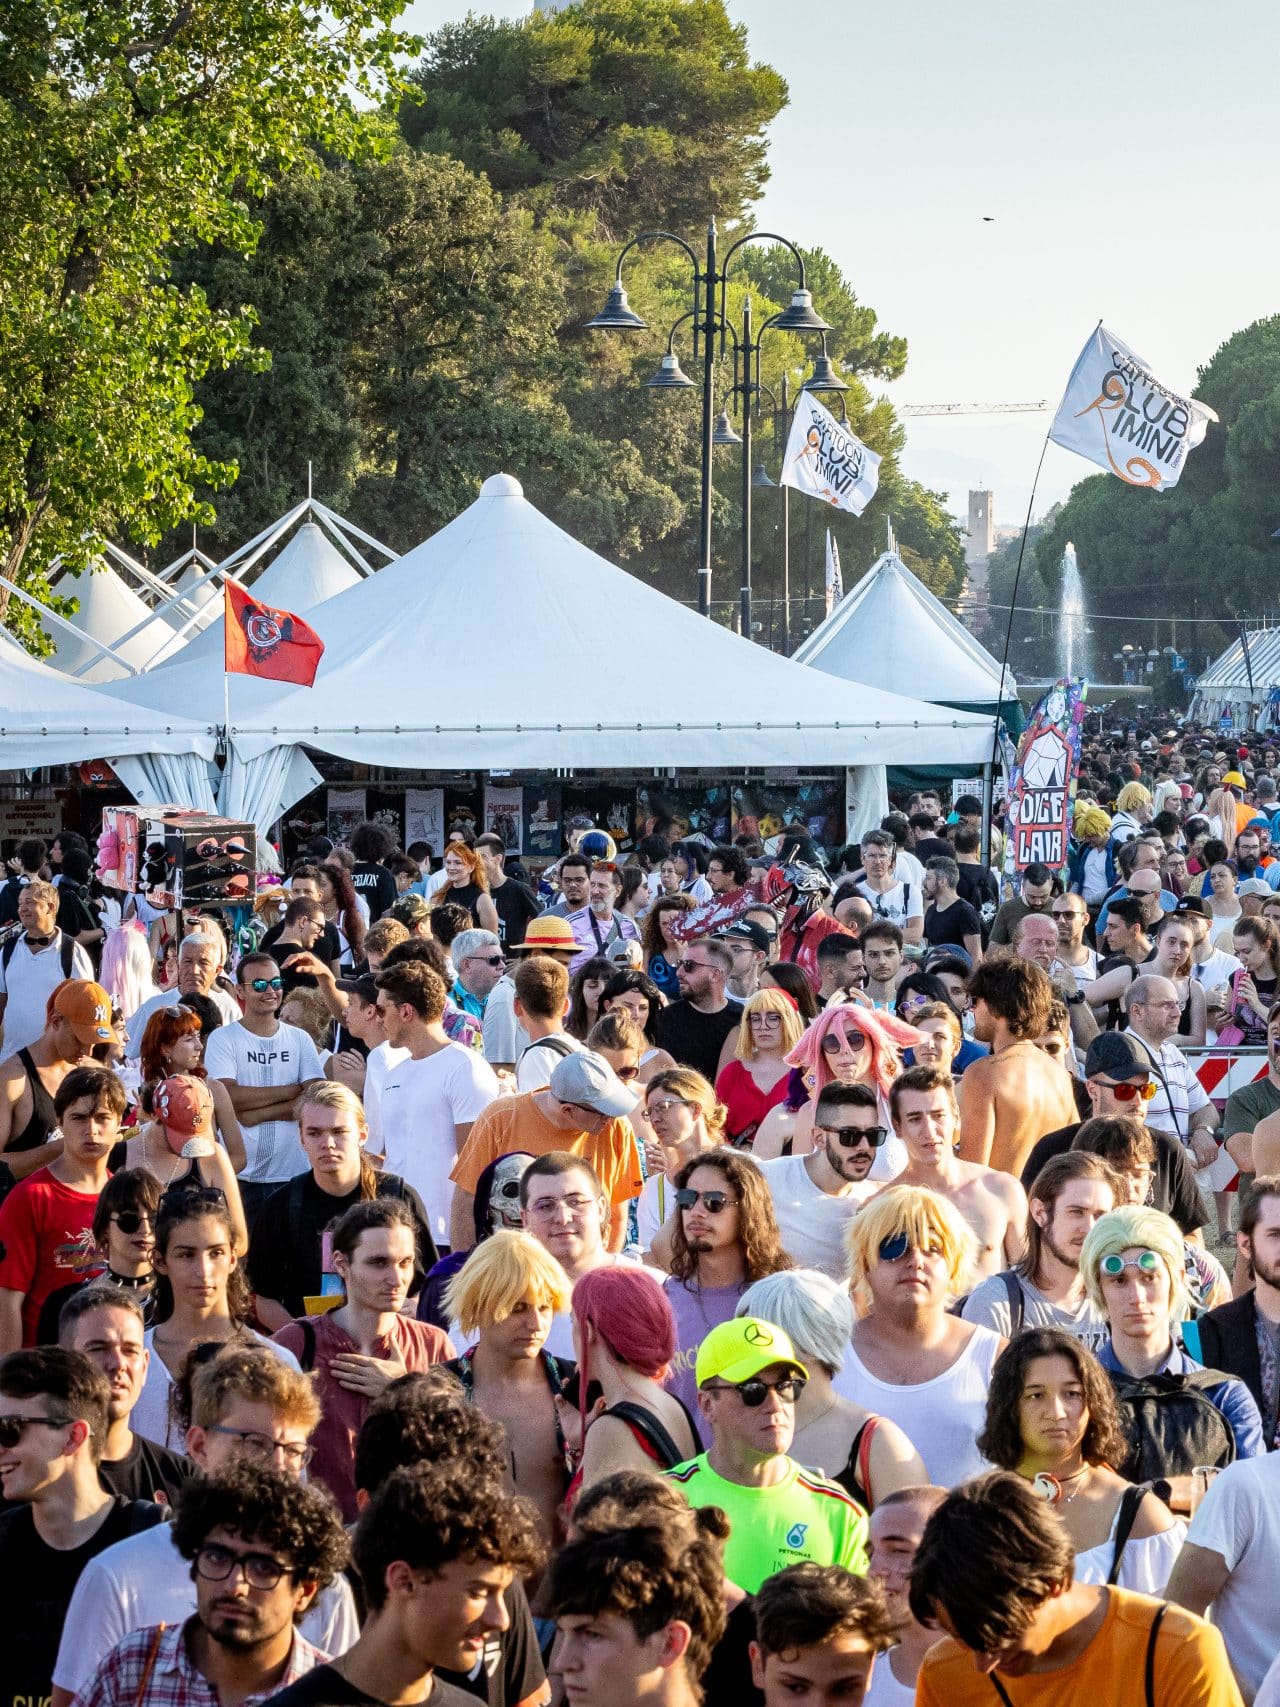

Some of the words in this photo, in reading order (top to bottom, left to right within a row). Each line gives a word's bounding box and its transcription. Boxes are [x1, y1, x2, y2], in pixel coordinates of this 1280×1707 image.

[1101, 370, 1190, 439] CLUB
[806, 424, 860, 480] CLUB
[1020, 791, 1065, 825] DICE
[1018, 830, 1063, 864] LAIR
[247, 1050, 290, 1065] NOPE
[778, 1548, 812, 1559] PETRONAS
